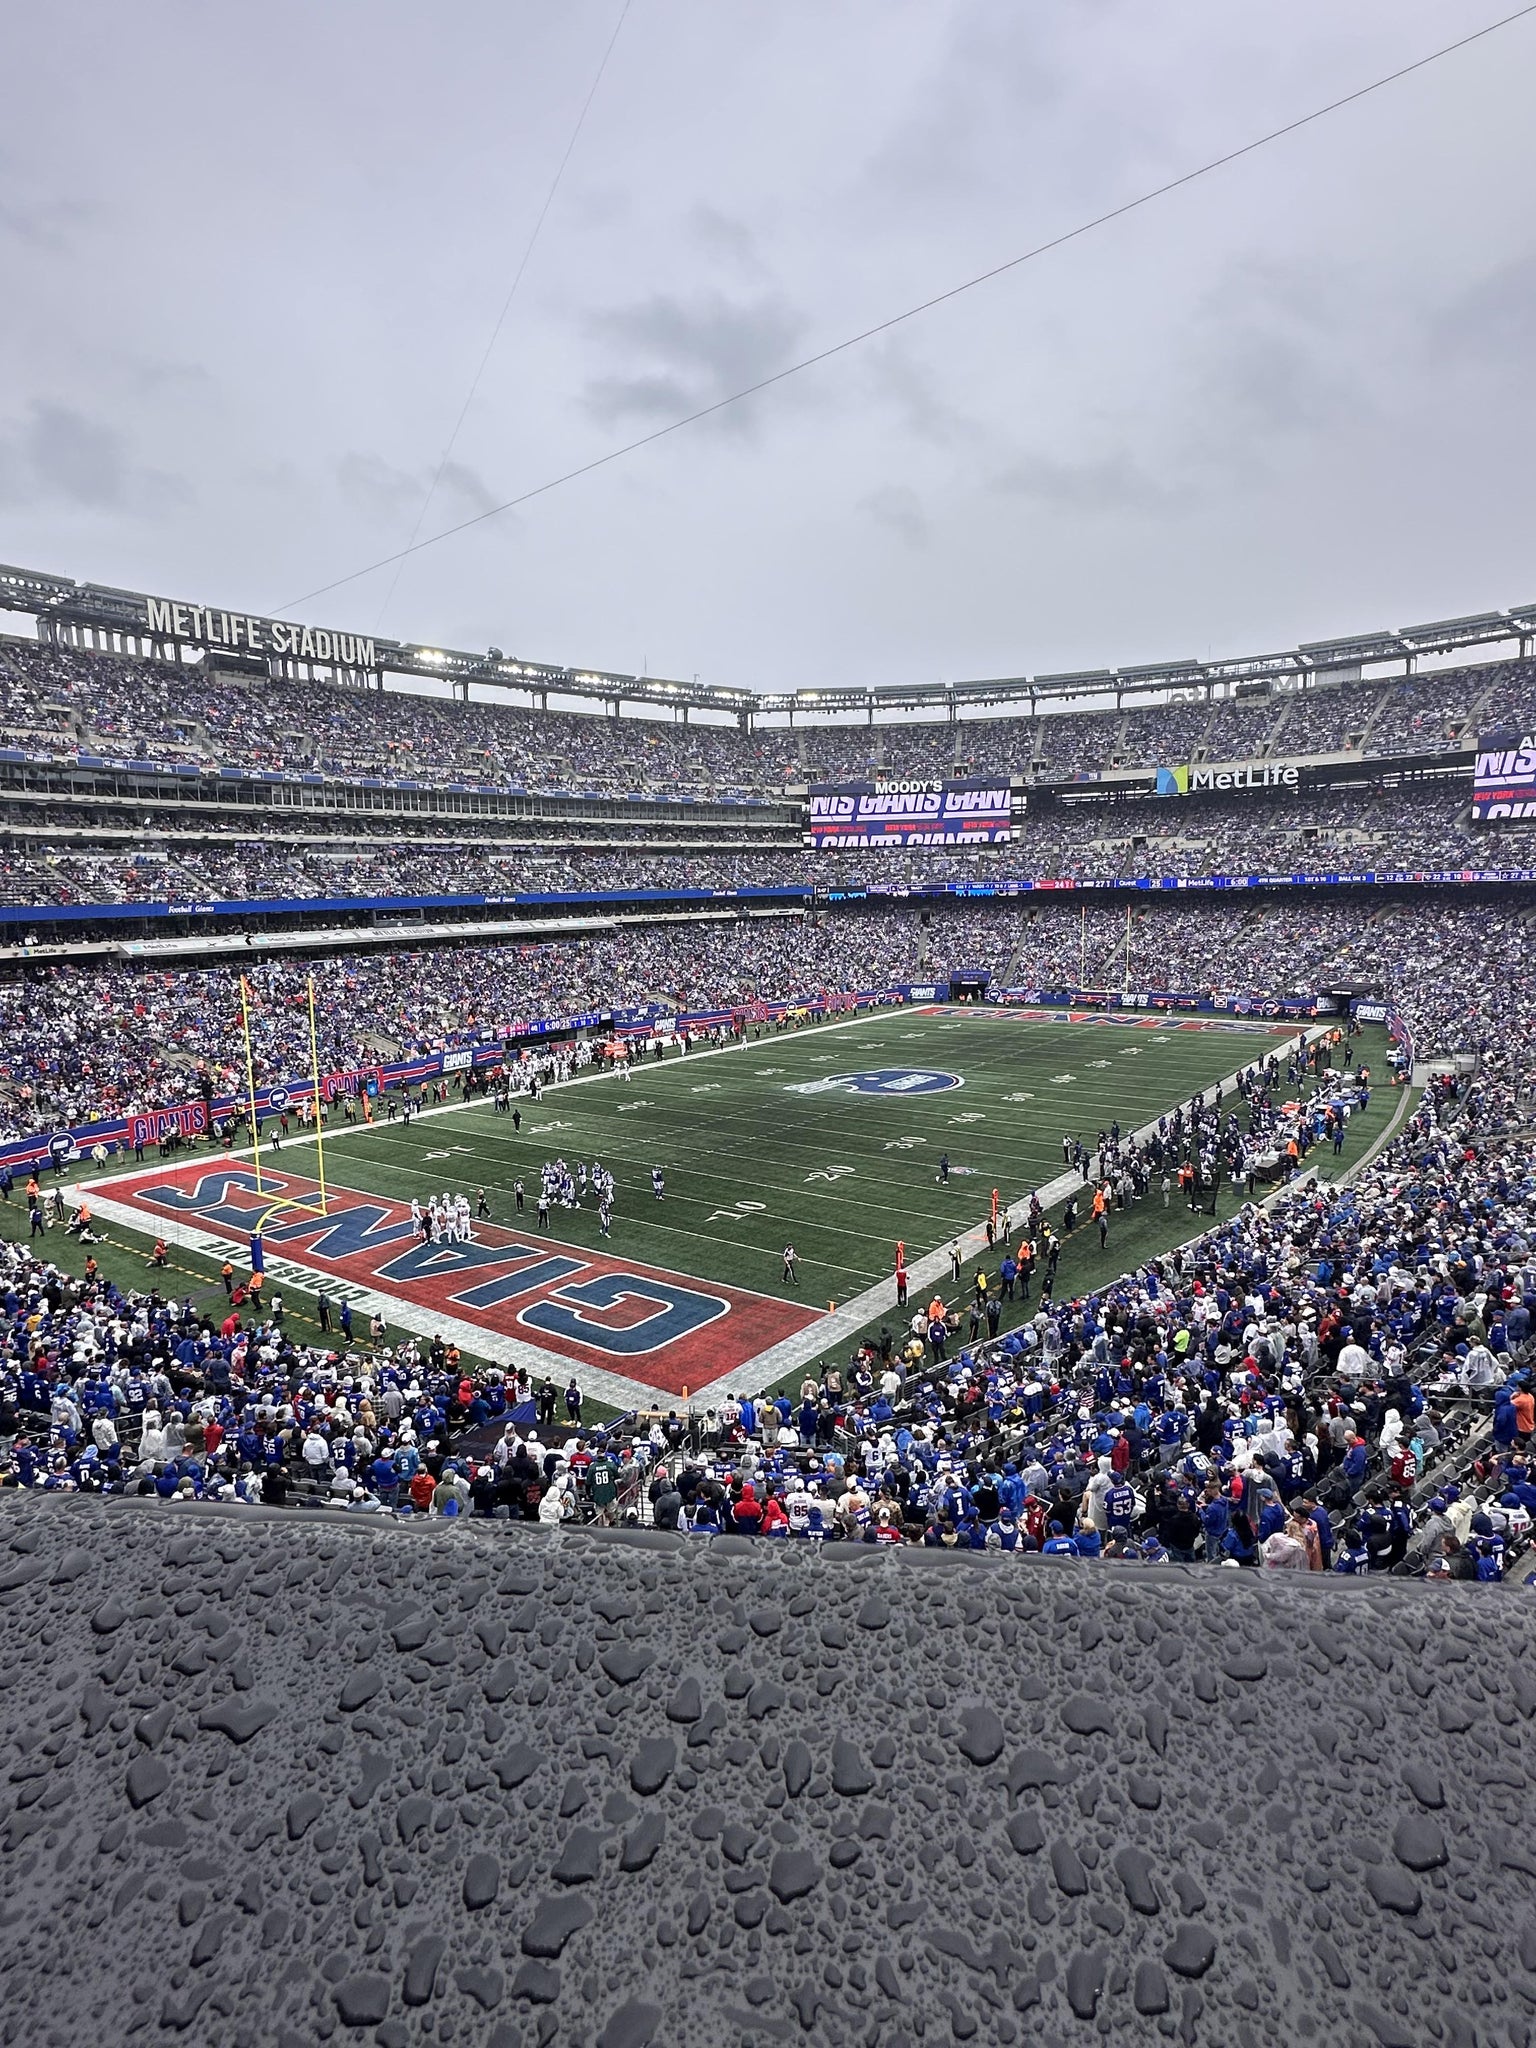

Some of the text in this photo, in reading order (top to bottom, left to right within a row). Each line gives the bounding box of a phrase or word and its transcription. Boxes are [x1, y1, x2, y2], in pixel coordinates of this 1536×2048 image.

[147, 598, 376, 667] METLIFE STADIUM
[1192, 763, 1299, 791] MetLife
[875, 780, 943, 795] MOODY'S
[1188, 878, 1214, 887] MetLife
[33, 947, 57, 955] MetLife
[1356, 1005, 1387, 1018] GIANTS
[545, 1021, 560, 1031] 6:00
[654, 1018, 677, 1031] GIANTS
[443, 1051, 473, 1070] GIANTS
[133, 1105, 208, 1143] GIANTS
[884, 1136, 928, 1150] 30
[805, 1165, 856, 1182] 20
[706, 1201, 767, 1222] 10
[132, 1170, 732, 1356] GIANTS
[263, 1261, 372, 1302] CHOOSE
[518, 1384, 530, 1395] 85
[423, 1418, 431, 1428] 6
[1173, 1421, 1179, 1433] 5
[334, 1448, 346, 1461] 13
[872, 1450, 879, 1460] 6
[401, 1458, 409, 1471] 2
[1192, 1455, 1212, 1471] 80
[595, 1470, 609, 1483] 68
[1291, 1462, 1304, 1478] 90
[1403, 1466, 1416, 1478] 85
[794, 1505, 808, 1517] 85
[956, 1497, 965, 1516] 1
[1112, 1501, 1132, 1516] 53
